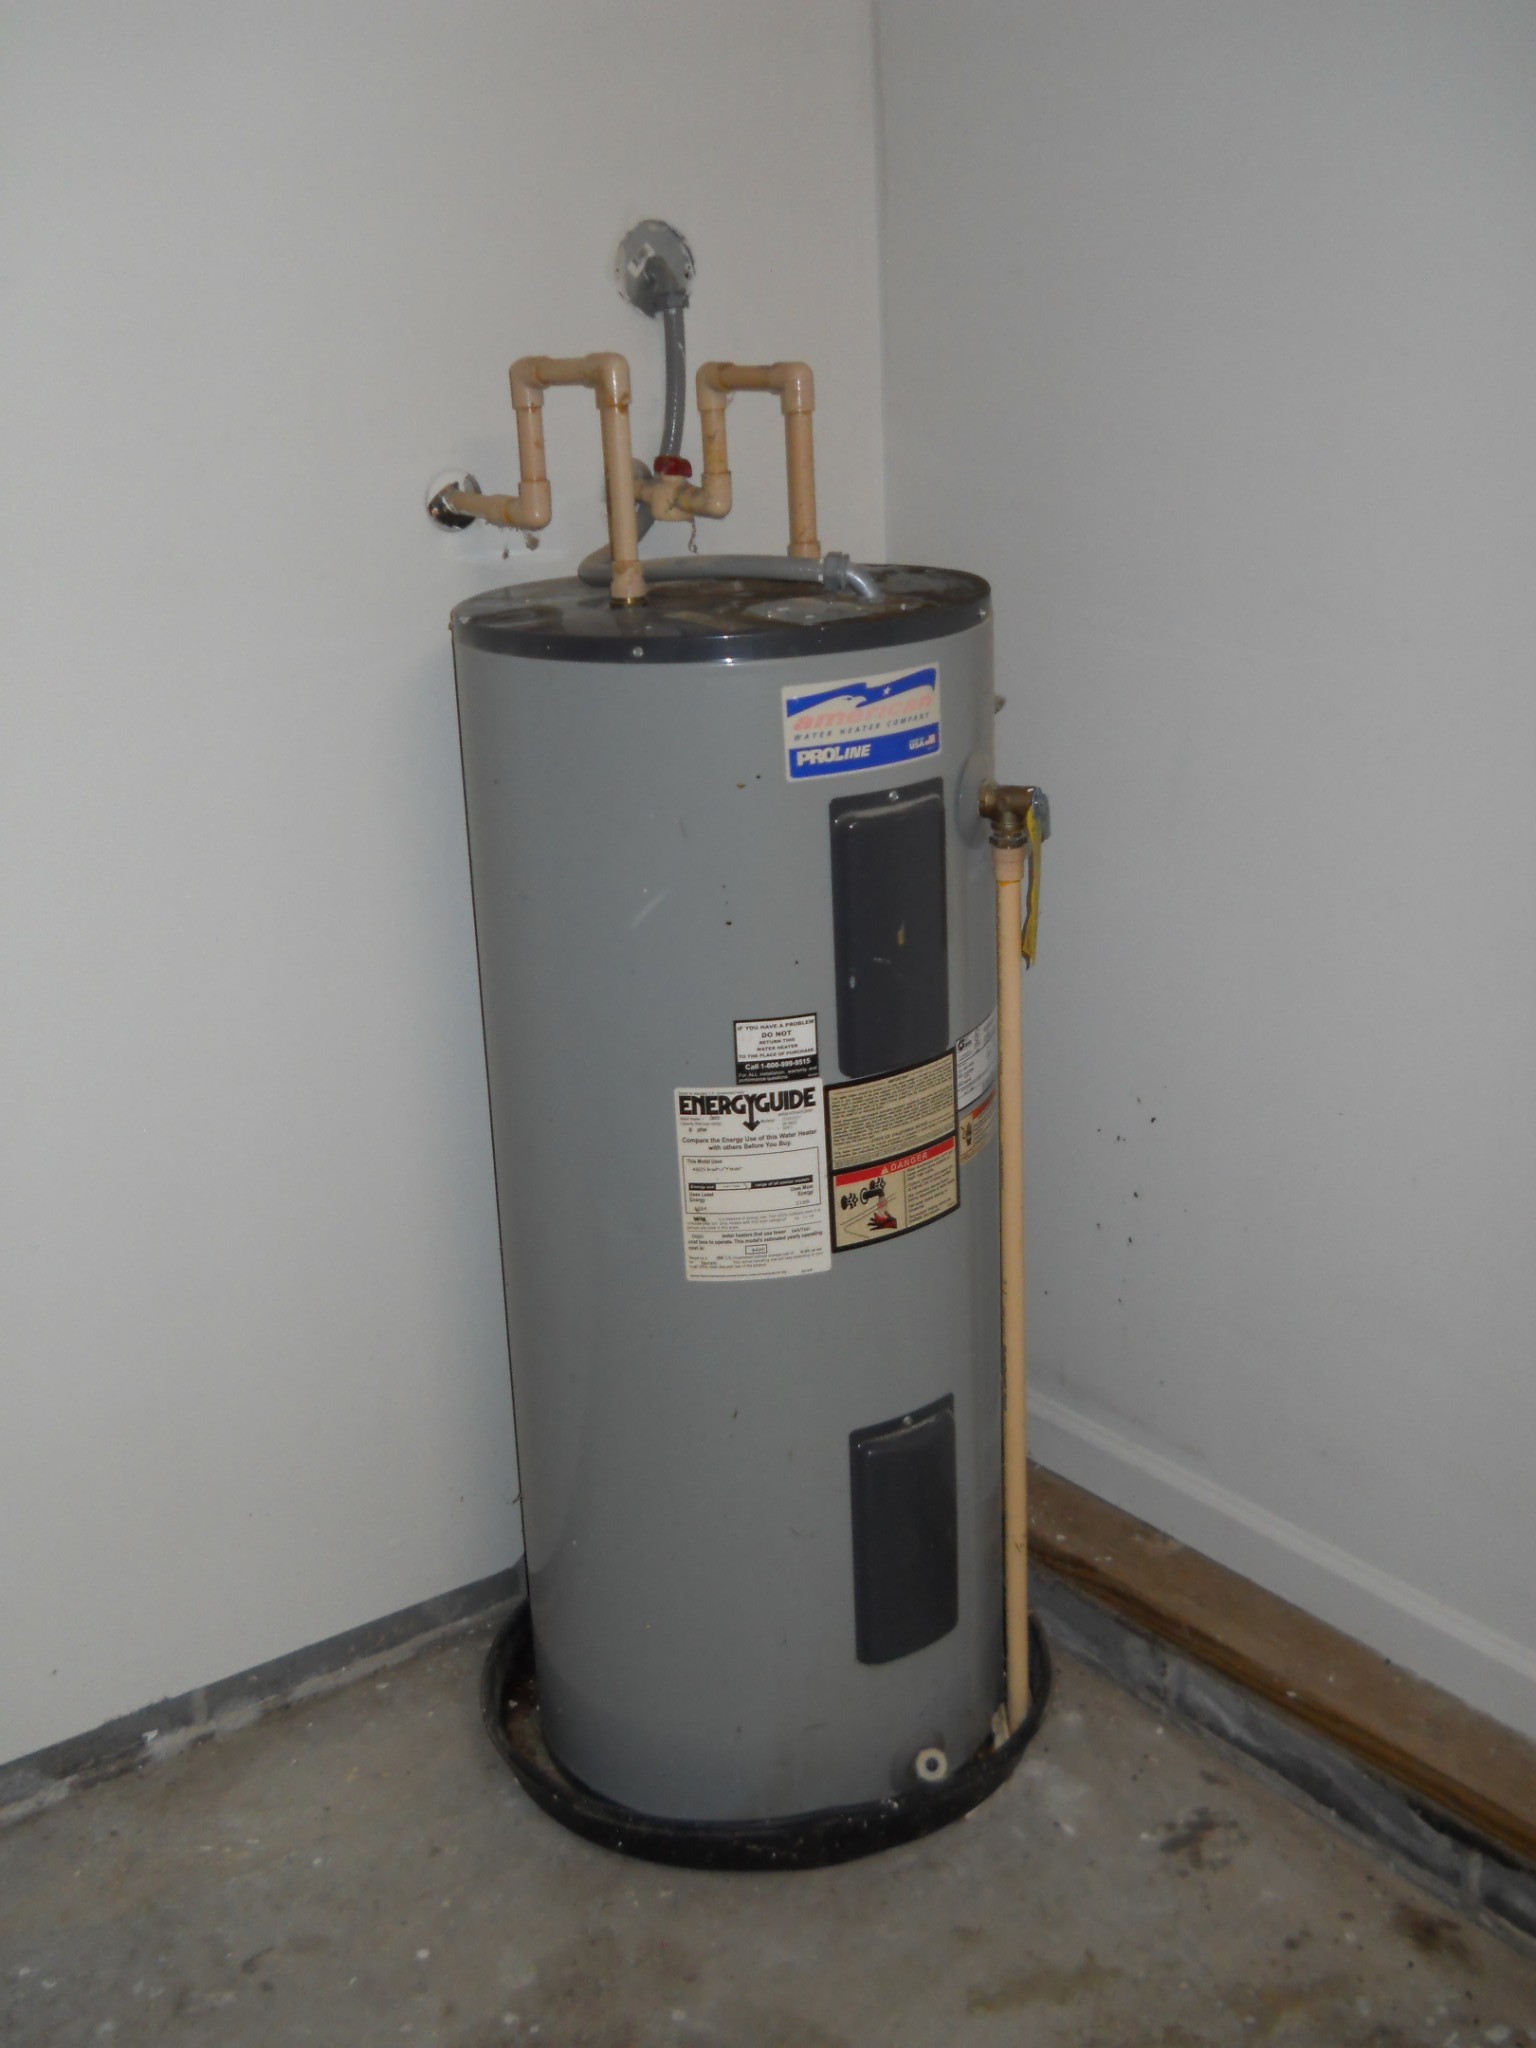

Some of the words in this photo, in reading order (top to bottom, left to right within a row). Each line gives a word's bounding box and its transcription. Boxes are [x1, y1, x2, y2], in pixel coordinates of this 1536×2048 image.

[793, 694, 933, 731] american
[794, 730, 832, 742] WATER
[840, 723, 880, 735] HEATER
[887, 712, 930, 727] COMPANY
[909, 740, 924, 750] USA
[797, 744, 871, 766] PROLINE
[785, 1019, 814, 1027] PROBLEM
[761, 1031, 773, 1039] DO
[786, 1047, 814, 1055] PURCHASE
[745, 1063, 759, 1071] Call
[678, 1086, 816, 1116] ENERGYGUIDE
[721, 1136, 744, 1144] Energy
[797, 1129, 817, 1137] Heater
[890, 1151, 929, 1171] DANGER
